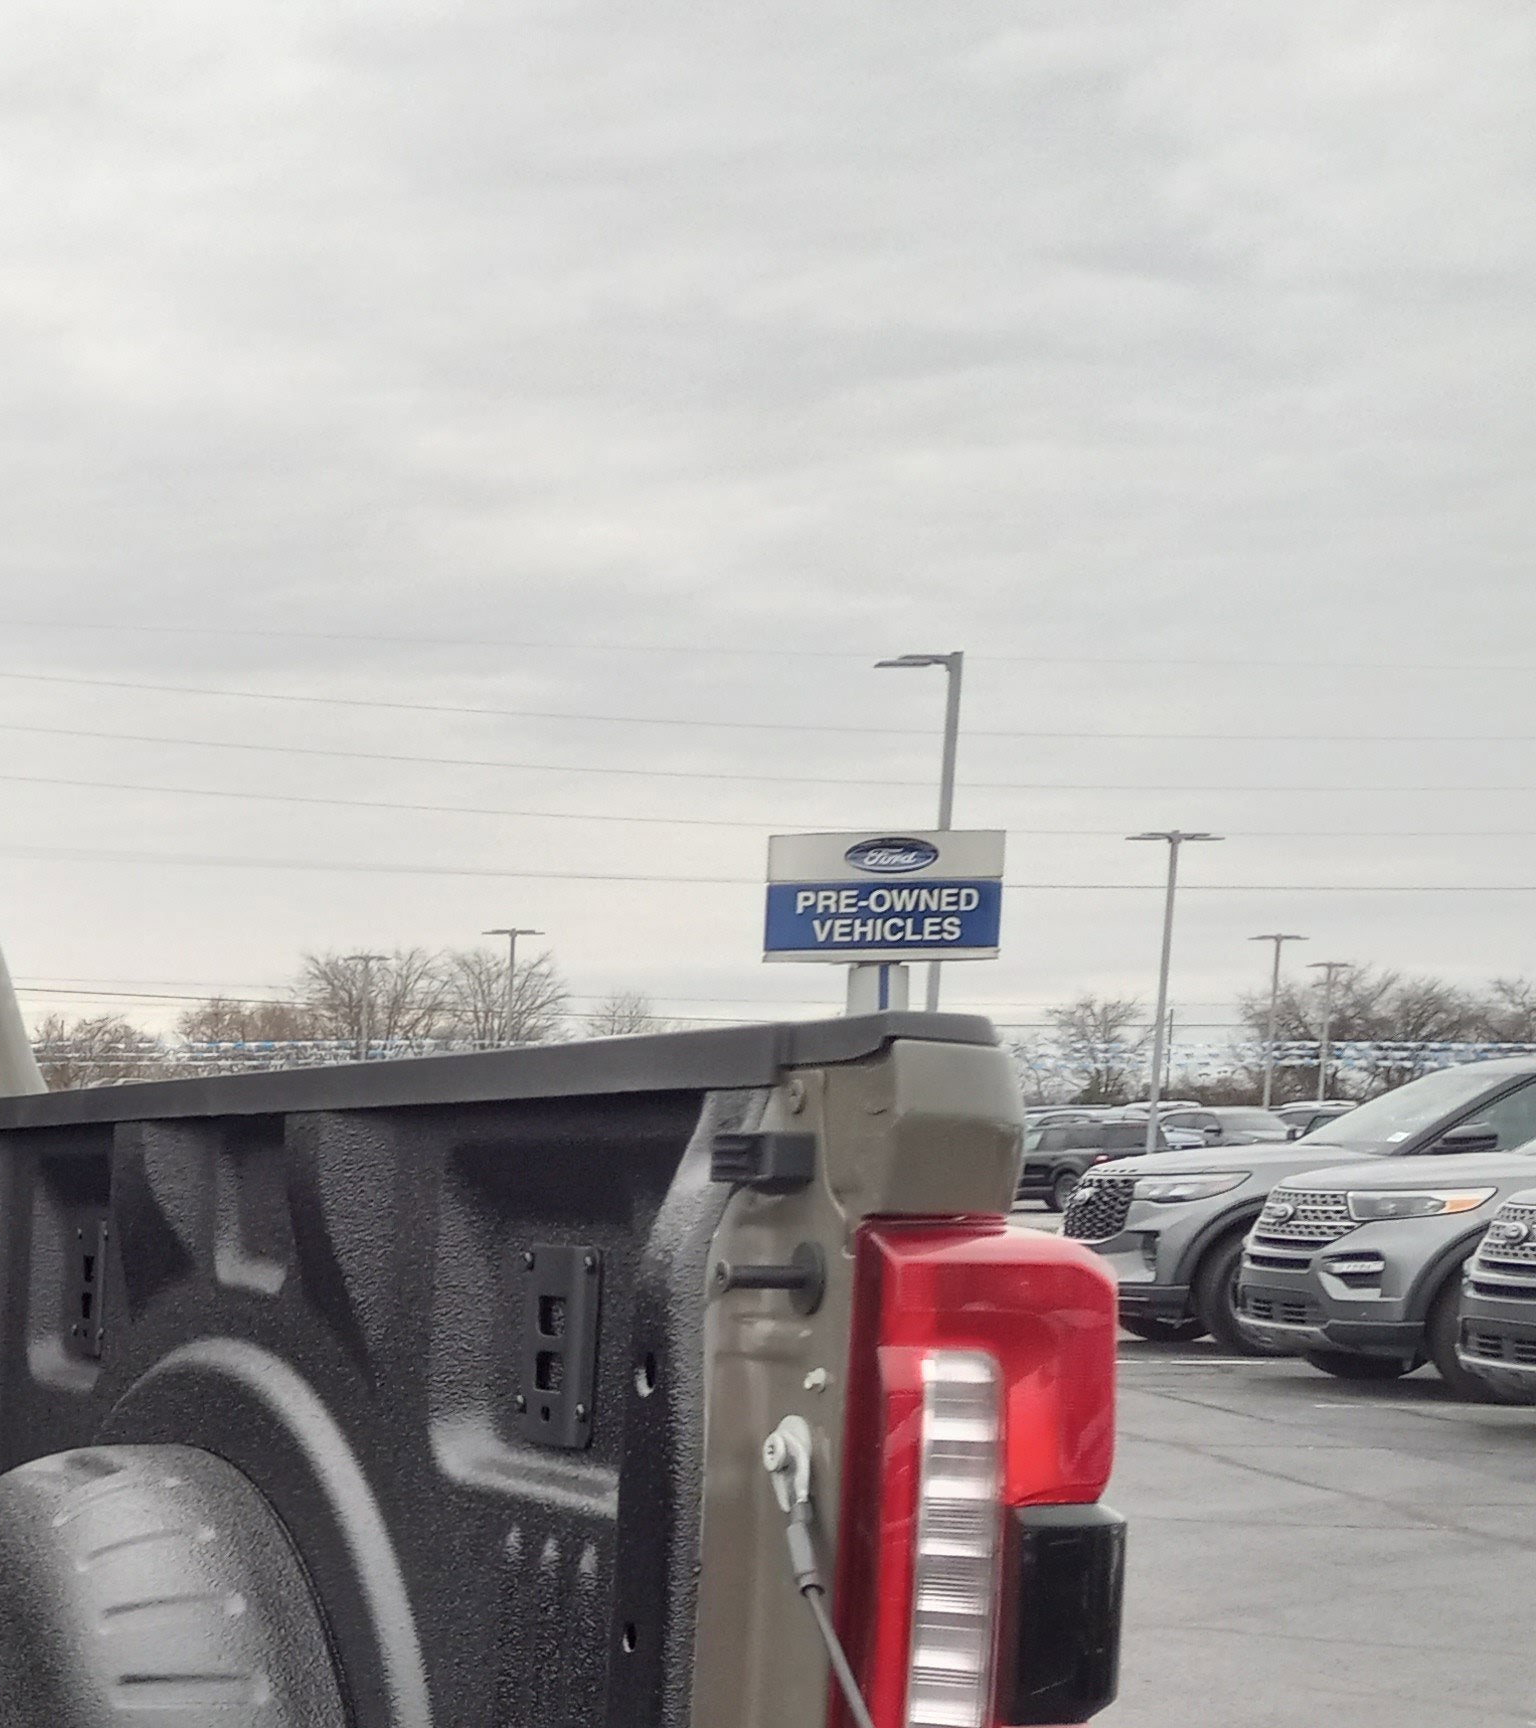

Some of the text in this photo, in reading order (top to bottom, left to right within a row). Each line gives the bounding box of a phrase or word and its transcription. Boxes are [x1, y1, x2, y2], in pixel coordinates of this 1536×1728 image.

[862, 847, 917, 866] Ford
[795, 887, 980, 915] PRE-OWNED
[812, 917, 962, 942] VEHICLES
